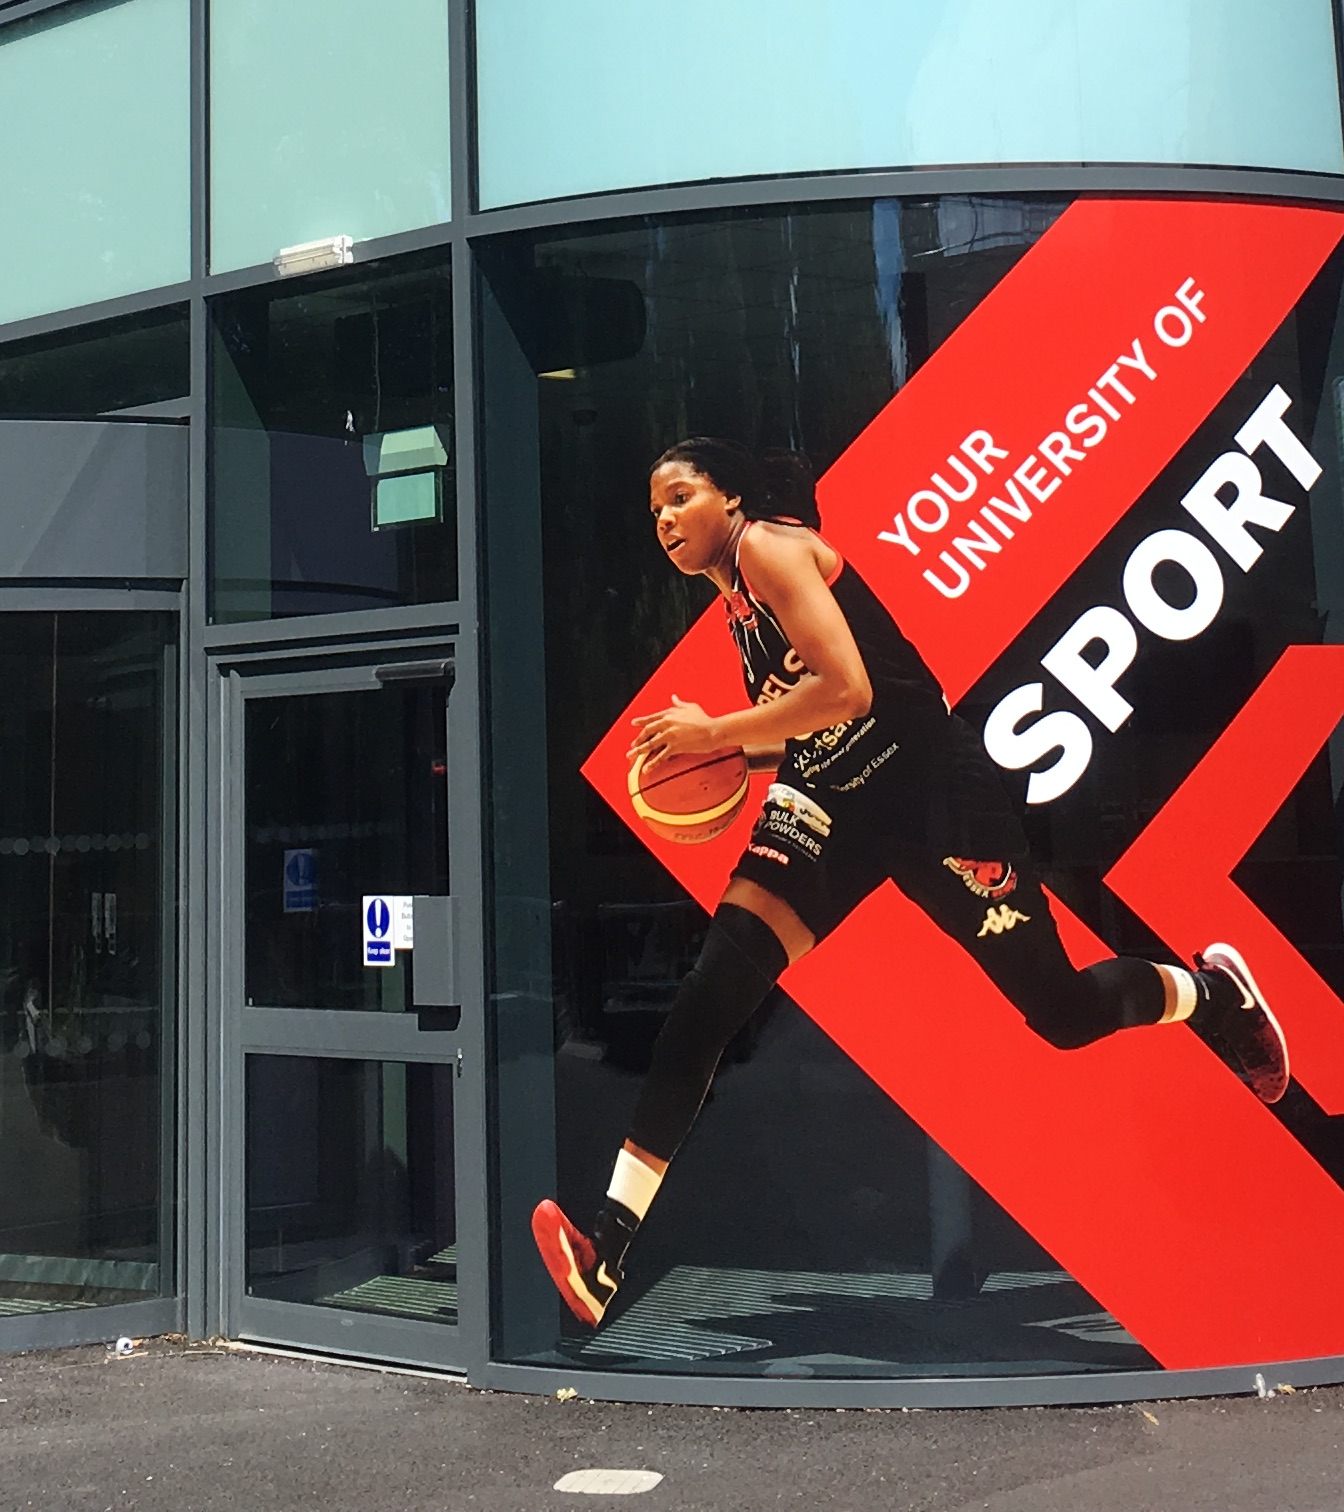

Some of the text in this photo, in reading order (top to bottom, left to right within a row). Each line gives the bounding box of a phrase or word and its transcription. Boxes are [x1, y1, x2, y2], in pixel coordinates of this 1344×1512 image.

[877, 430, 1009, 556] YOUR
[923, 277, 1206, 598] UNIVERSITY OF
[983, 383, 1323, 805] SPORT
[764, 820, 822, 856] POWDERS
[769, 809, 799, 827] BULK
